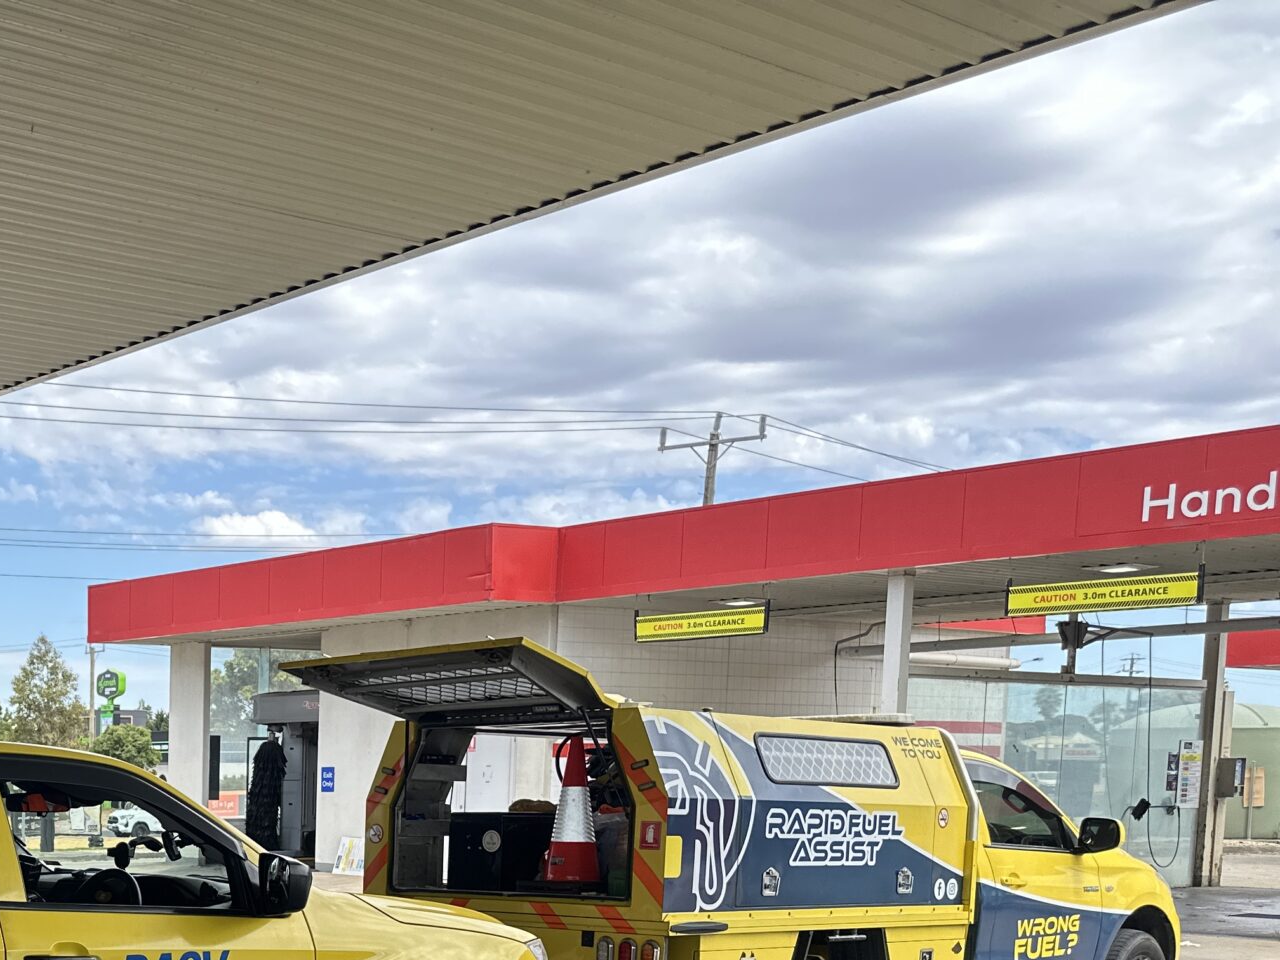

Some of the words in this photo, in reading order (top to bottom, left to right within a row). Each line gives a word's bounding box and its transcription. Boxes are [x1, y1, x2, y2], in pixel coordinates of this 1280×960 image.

[1141, 470, 1278, 522] Hand
[1033, 593, 1077, 604] CAUTION
[1082, 591, 1107, 601] 3.0m
[1109, 586, 1169, 599] CLEARANCE
[653, 622, 684, 632] CAUTION
[687, 620, 704, 630] 3.0m
[704, 618, 746, 629] CLEARANCE
[891, 736, 910, 747] WE
[910, 738, 942, 749] COME
[901, 748, 917, 759] TO
[918, 749, 942, 760] YOU
[322, 771, 333, 779] Exit
[322, 780, 334, 789] Only
[789, 837, 884, 866] ASSIST
[1017, 913, 1081, 938] WRONG
